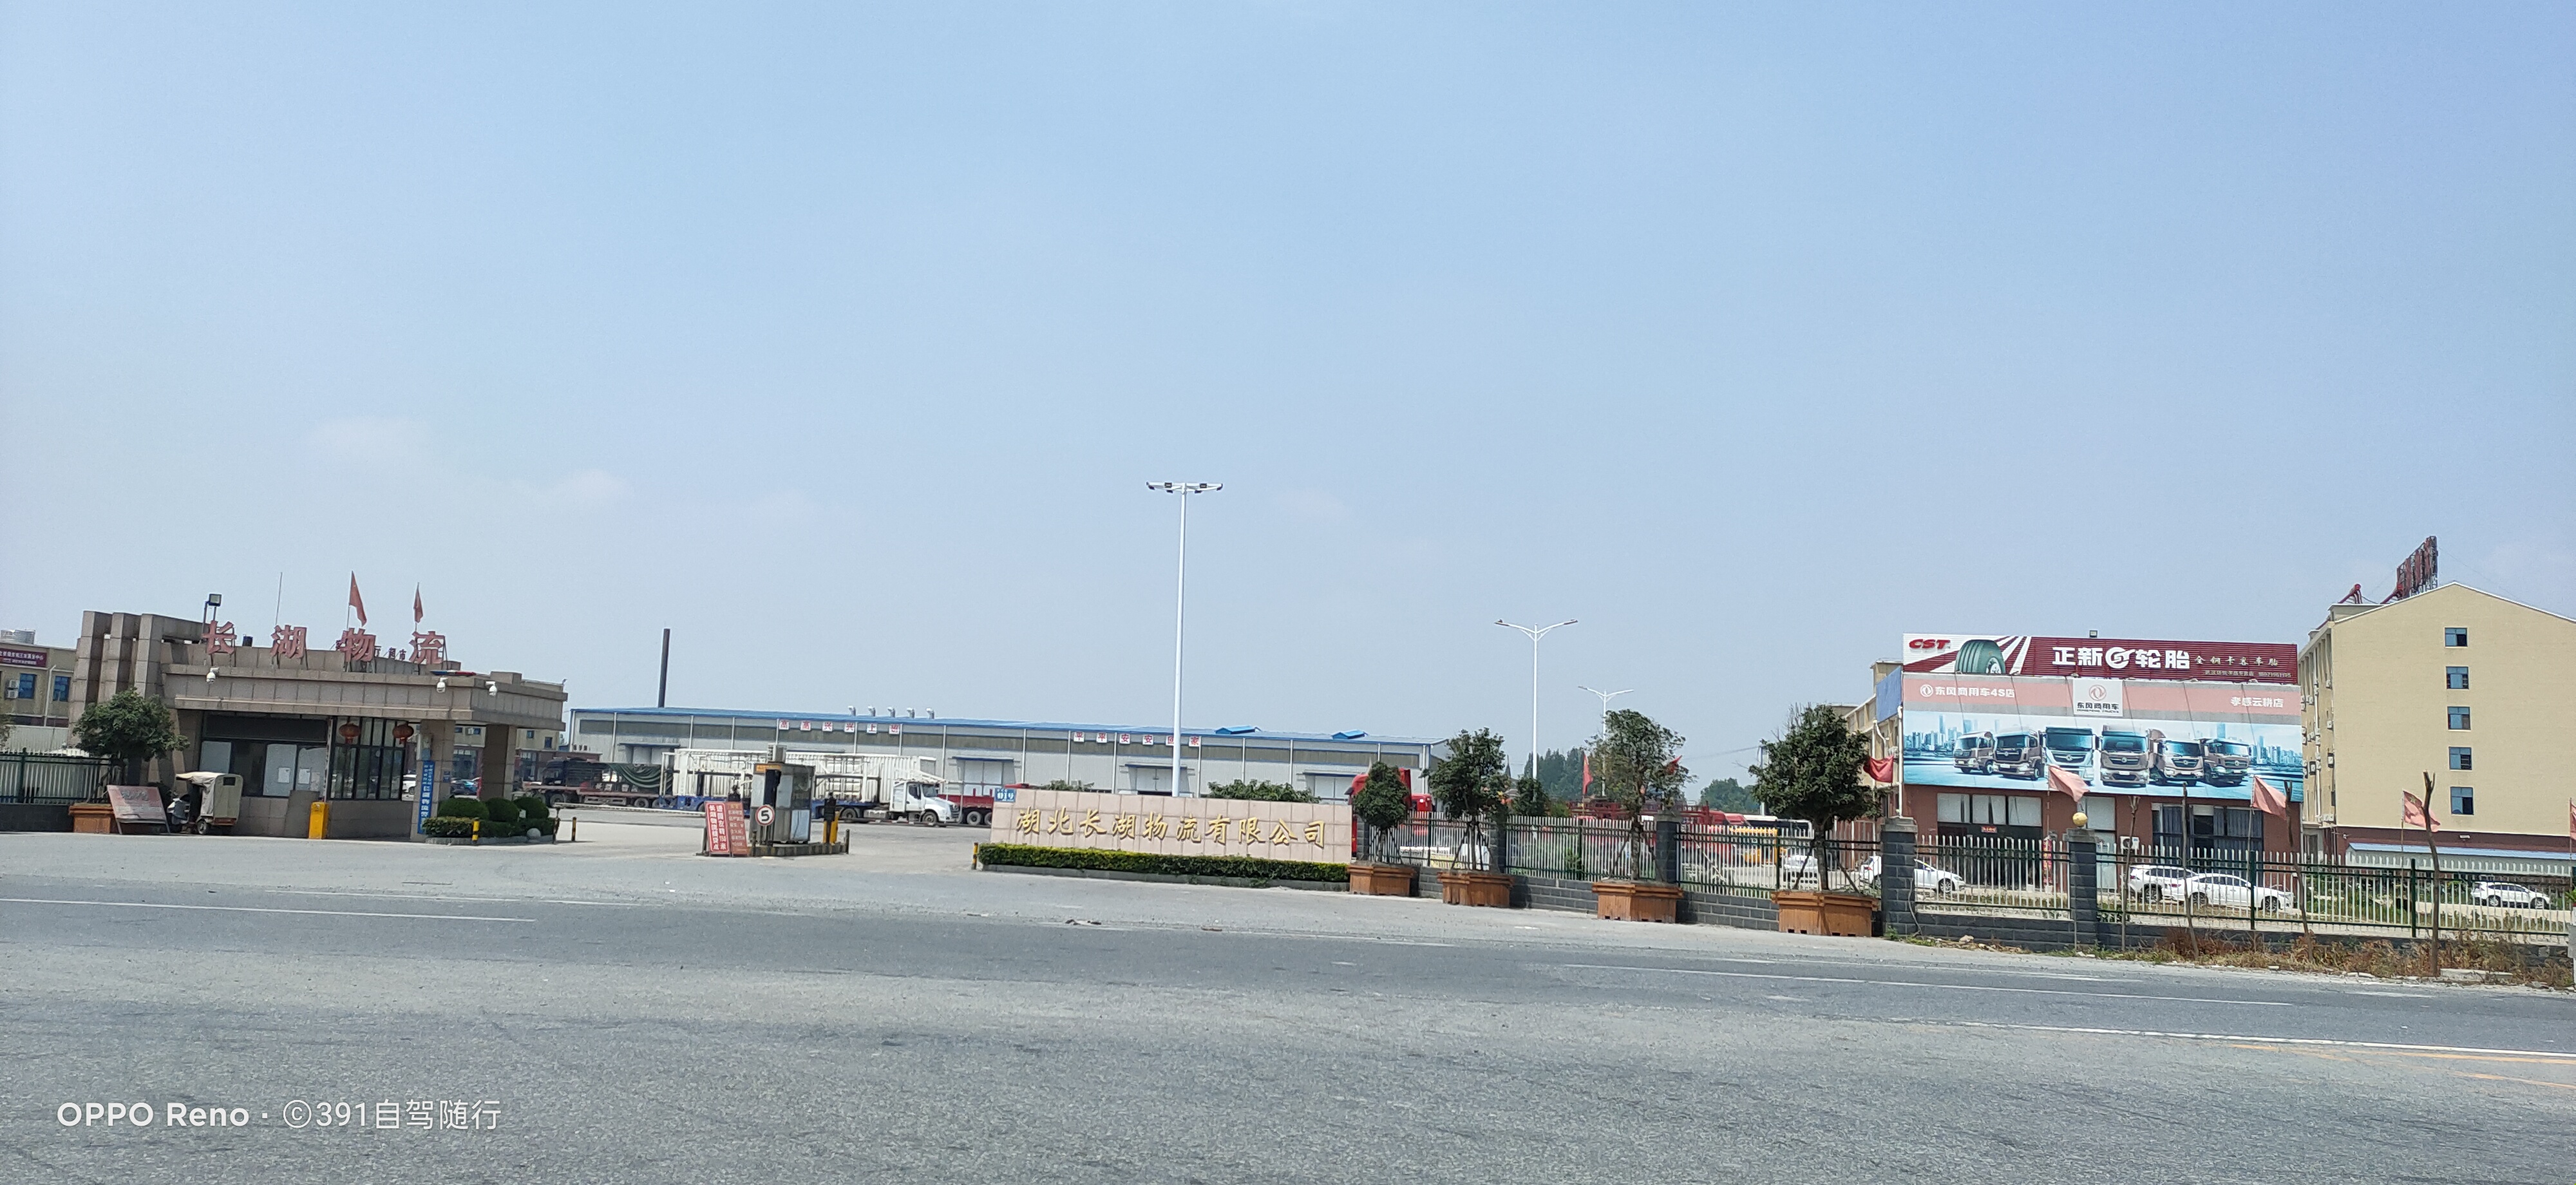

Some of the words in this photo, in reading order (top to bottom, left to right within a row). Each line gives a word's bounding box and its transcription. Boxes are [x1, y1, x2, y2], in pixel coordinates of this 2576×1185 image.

[202, 620, 445, 665] 长湖物流
[1909, 639, 1950, 649] CST
[2052, 647, 2103, 667] 正新
[2136, 649, 2190, 669] 轮胎
[1935, 686, 2015, 698] 东风商用车4S店
[2077, 702, 2119, 710] 东风商用车
[761, 810, 770, 822] 5
[1016, 806, 1326, 849] 湖北长湖物流有限公司
